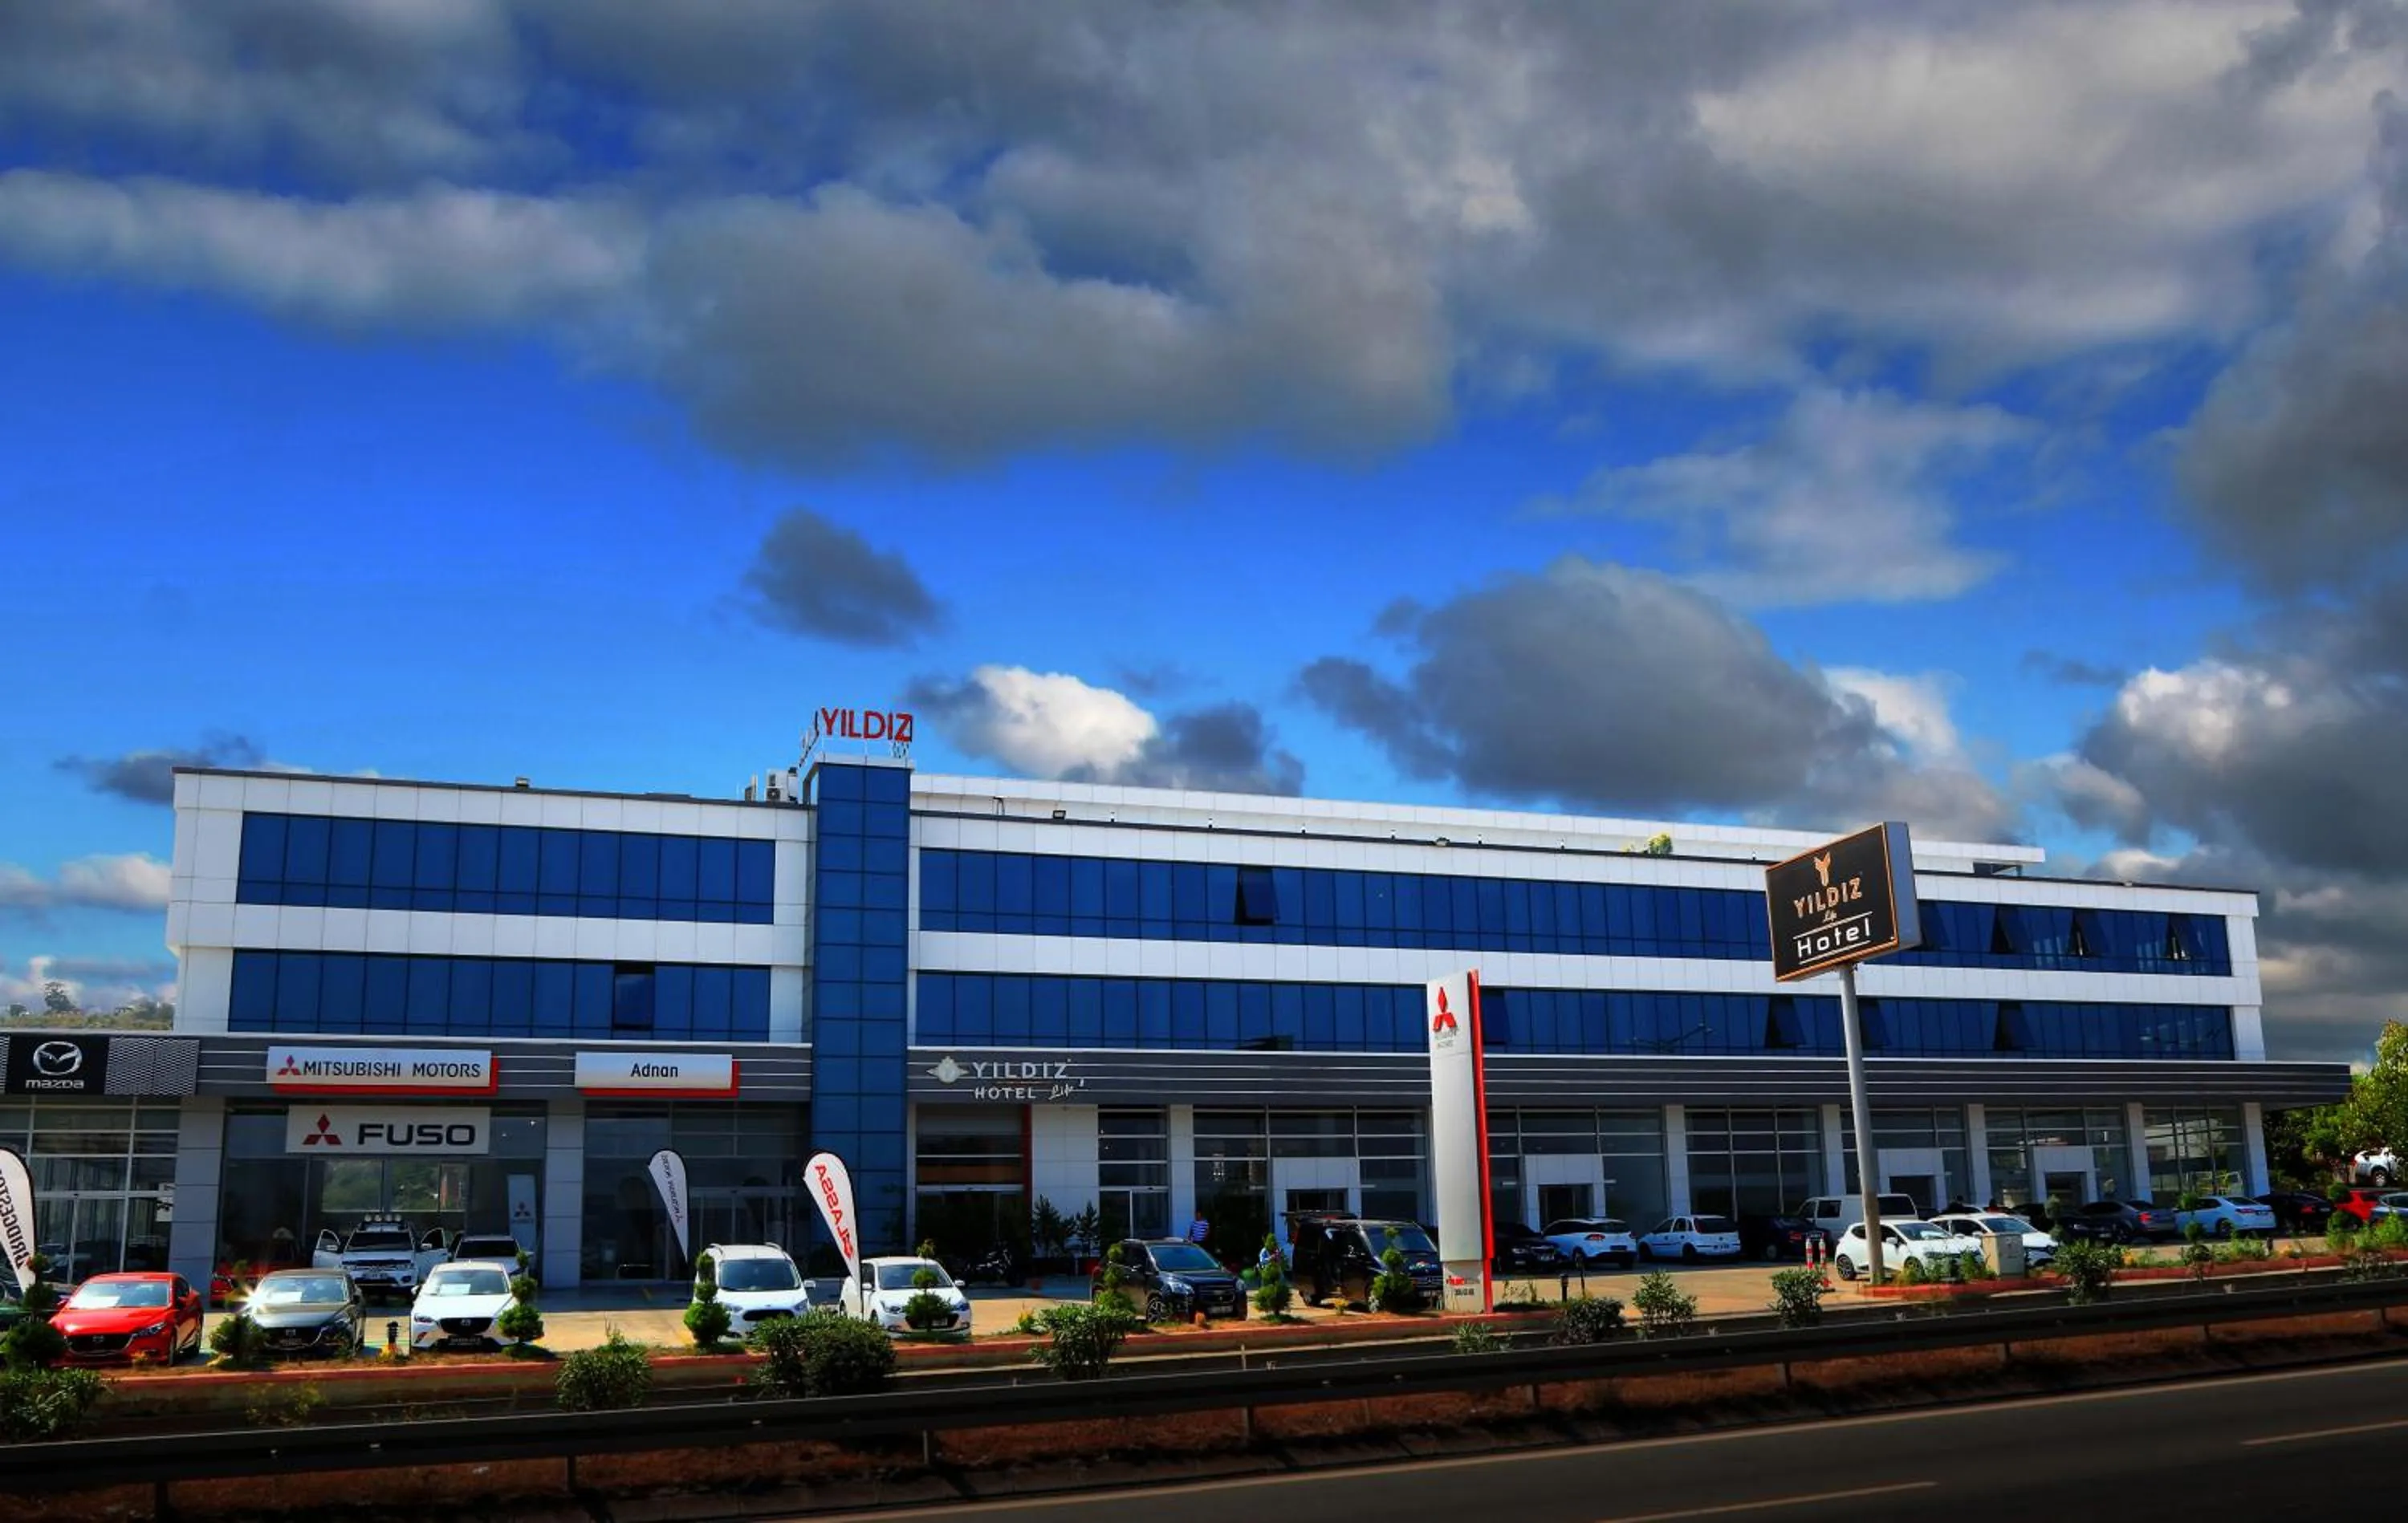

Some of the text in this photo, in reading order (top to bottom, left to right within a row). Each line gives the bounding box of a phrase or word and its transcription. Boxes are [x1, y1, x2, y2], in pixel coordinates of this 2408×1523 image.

[821, 707, 913, 742] YILDIZ
[1794, 877, 1862, 918] YILDIZ
[1797, 917, 1870, 957] Hotel
[303, 1061, 480, 1078] MITSUBISHI MOTORS
[630, 1062, 678, 1078] Adnan
[972, 1062, 1068, 1078] YILDIZ
[974, 1086, 1036, 1099] HOTEL
[358, 1123, 475, 1145] FUSO
